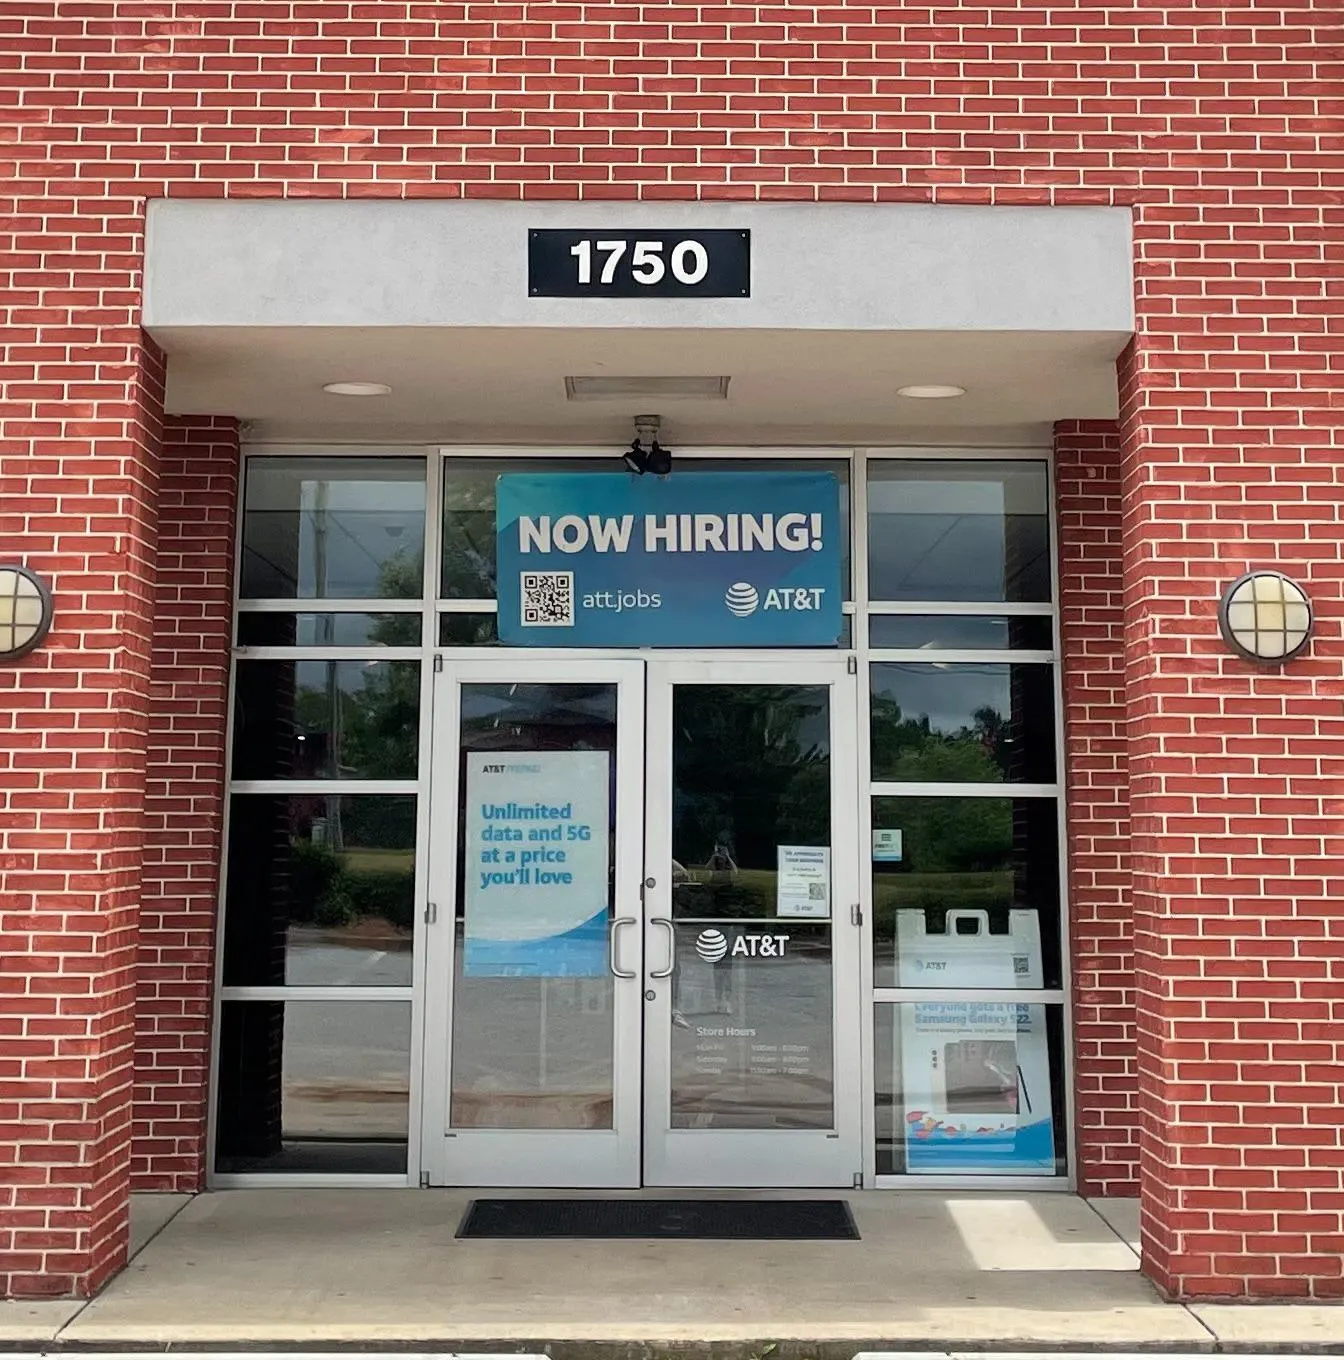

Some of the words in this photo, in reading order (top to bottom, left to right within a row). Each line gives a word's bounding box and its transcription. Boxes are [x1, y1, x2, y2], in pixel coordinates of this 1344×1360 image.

[570, 239, 709, 285] 1750
[519, 514, 635, 553] NOW
[645, 512, 824, 552] HIRING!
[582, 589, 662, 613] att.jobs
[763, 587, 826, 611] AT&T
[482, 764, 505, 773] AT&T
[481, 803, 572, 820] Unlimited
[481, 825, 524, 841] data
[528, 824, 563, 841] and
[567, 825, 592, 841] 5G
[481, 848, 500, 863] at
[504, 851, 515, 863] a
[521, 846, 566, 867] price
[535, 868, 573, 884] love
[731, 934, 790, 957] AT&T
[696, 1026, 724, 1037] Store
[726, 1027, 756, 1037] Hours
